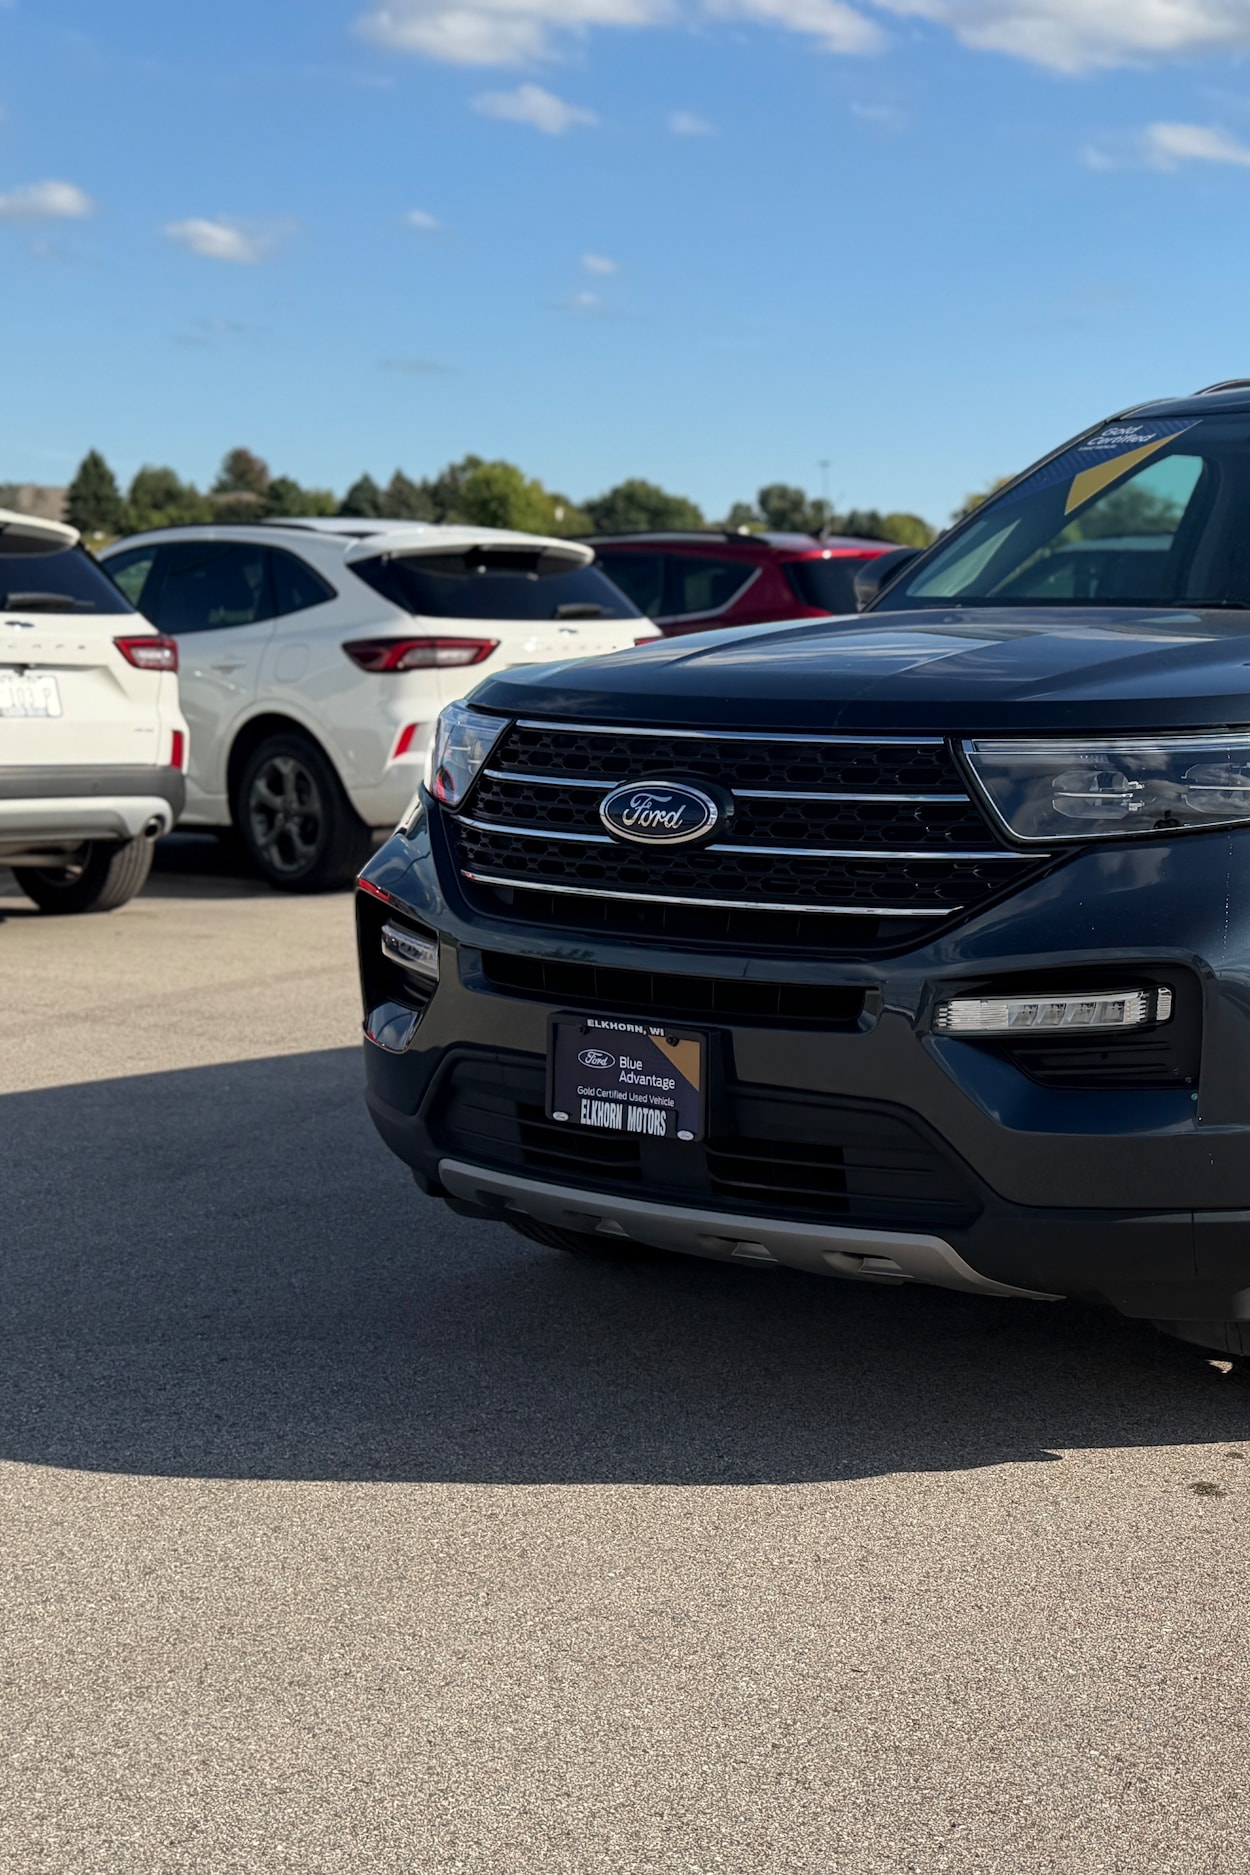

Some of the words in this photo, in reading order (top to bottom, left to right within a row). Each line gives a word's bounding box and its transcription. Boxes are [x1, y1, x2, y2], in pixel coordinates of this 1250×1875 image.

[1087, 433, 1156, 446] Certified
[1101, 425, 1143, 437] Gold
[622, 793, 687, 829] Ford
[587, 1019, 647, 1035] ELKHORN,
[649, 1027, 665, 1037] WI
[585, 1051, 608, 1066] Ford
[619, 1056, 642, 1070] Blue
[619, 1070, 675, 1090] Advantage
[577, 1085, 595, 1097] Gold
[596, 1088, 627, 1101] Certified
[629, 1092, 648, 1103] Used
[649, 1095, 675, 1107] Vehicle
[580, 1099, 622, 1130] ELKHORN
[627, 1105, 667, 1137] MOTORS
